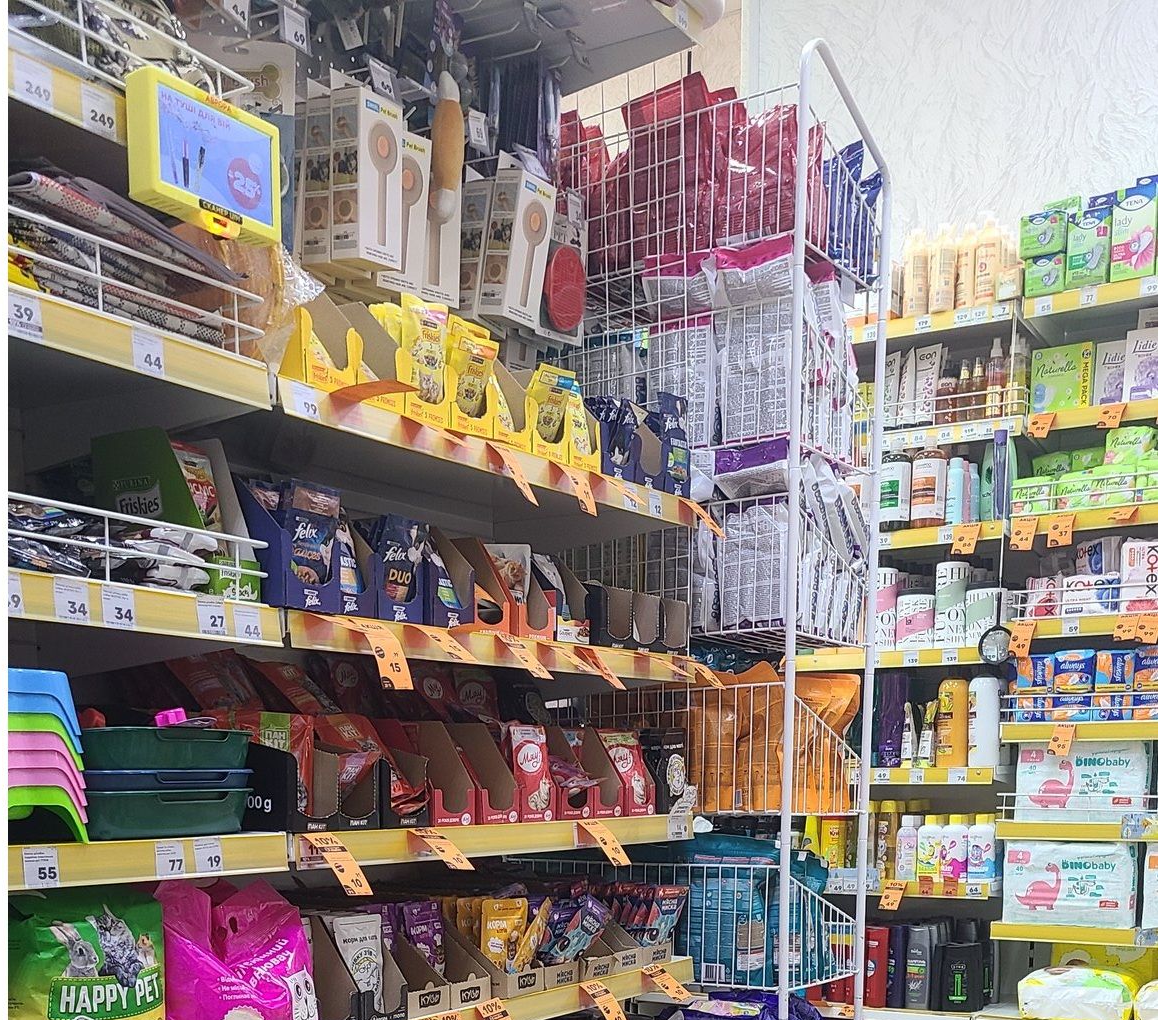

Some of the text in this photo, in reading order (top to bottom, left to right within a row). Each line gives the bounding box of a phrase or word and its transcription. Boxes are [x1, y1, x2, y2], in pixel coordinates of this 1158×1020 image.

[25, 80, 51, 102] 249
[90, 109, 114, 129] 249
[1125, 196, 1144, 207] TENA
[13, 304, 33, 321] 39
[1133, 339, 1157, 354] Lidie
[144, 353, 163, 370] 44
[1080, 361, 1090, 406] MEGA PACK
[303, 401, 317, 415] 99
[665, 417, 680, 432] felix
[119, 497, 160, 516] Friskies
[293, 522, 319, 541] felix
[1058, 530, 1068, 538] 37
[383, 547, 407, 563] felix
[389, 568, 412, 585] DUO
[68, 601, 88, 616] 34
[115, 607, 133, 621] 34
[210, 615, 225, 628] 27
[245, 625, 260, 637] 44
[390, 662, 401, 673] 15
[1060, 662, 1085, 671] always
[1114, 657, 1122, 682] always
[265, 731, 286, 742] ПАН
[168, 859, 183, 871] 77
[207, 856, 221, 868] 19
[38, 867, 57, 881] 55
[351, 878, 362, 888] 10
[59, 974, 160, 1013] HAPPY PET
